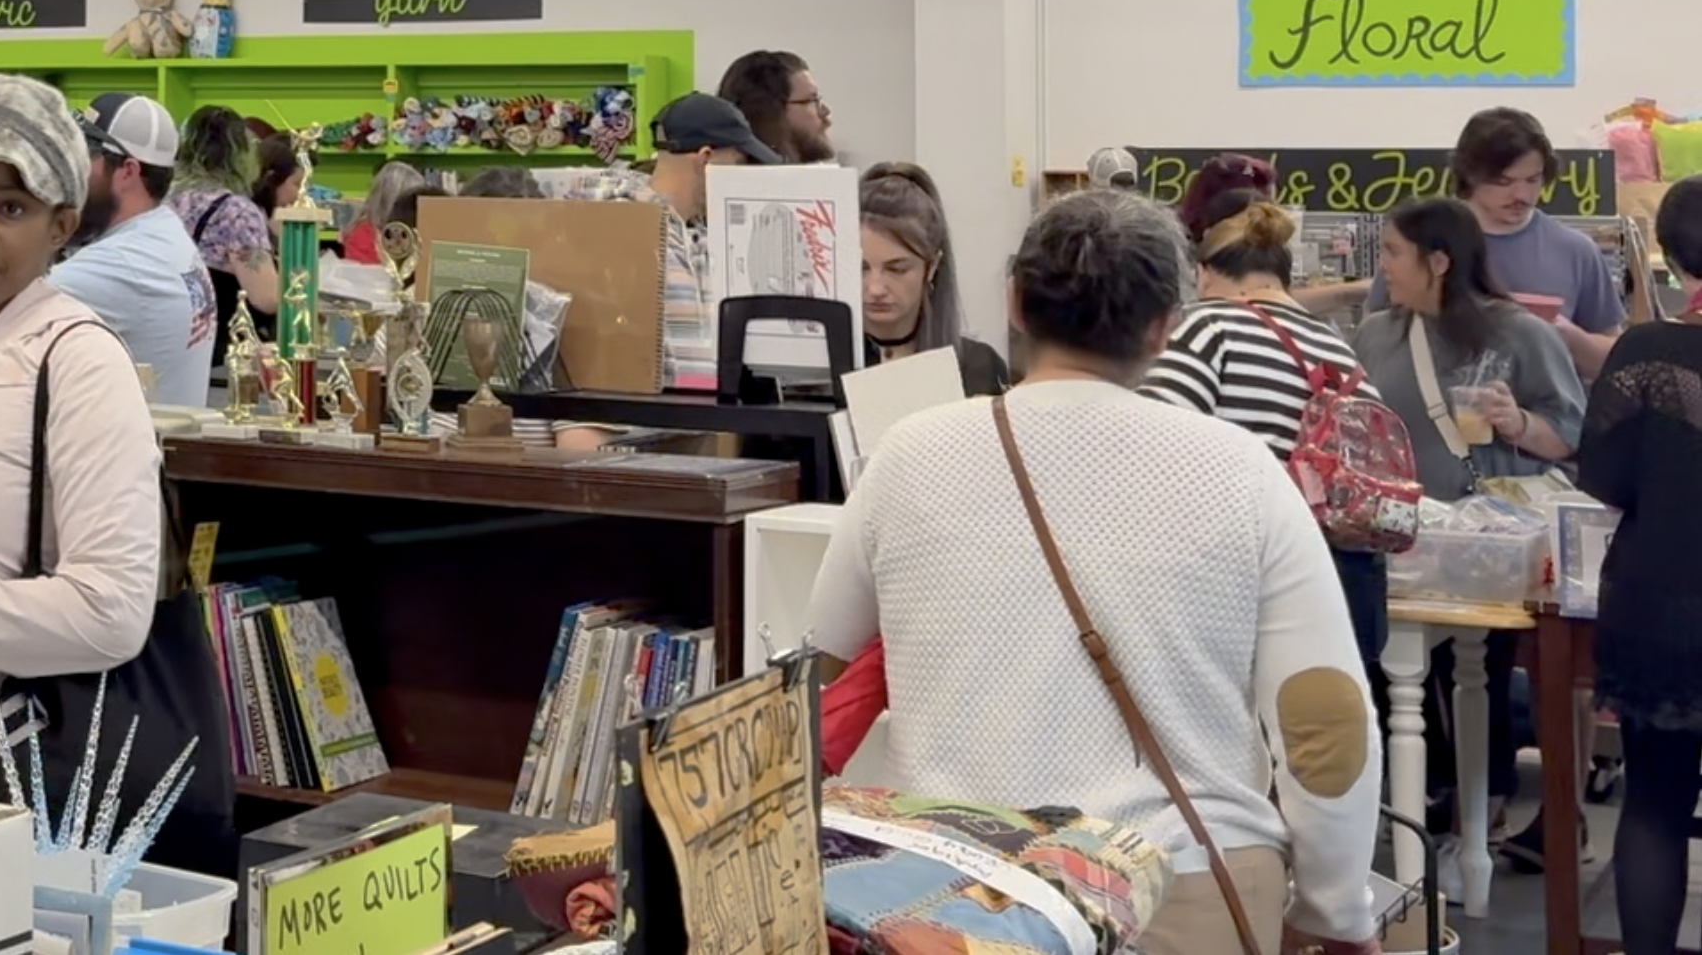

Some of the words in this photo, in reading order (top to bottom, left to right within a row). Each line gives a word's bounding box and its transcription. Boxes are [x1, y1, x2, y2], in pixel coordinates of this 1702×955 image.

[1327, 162, 1360, 211] &
[279, 886, 343, 950] MORE
[363, 846, 442, 912] QUILTS
